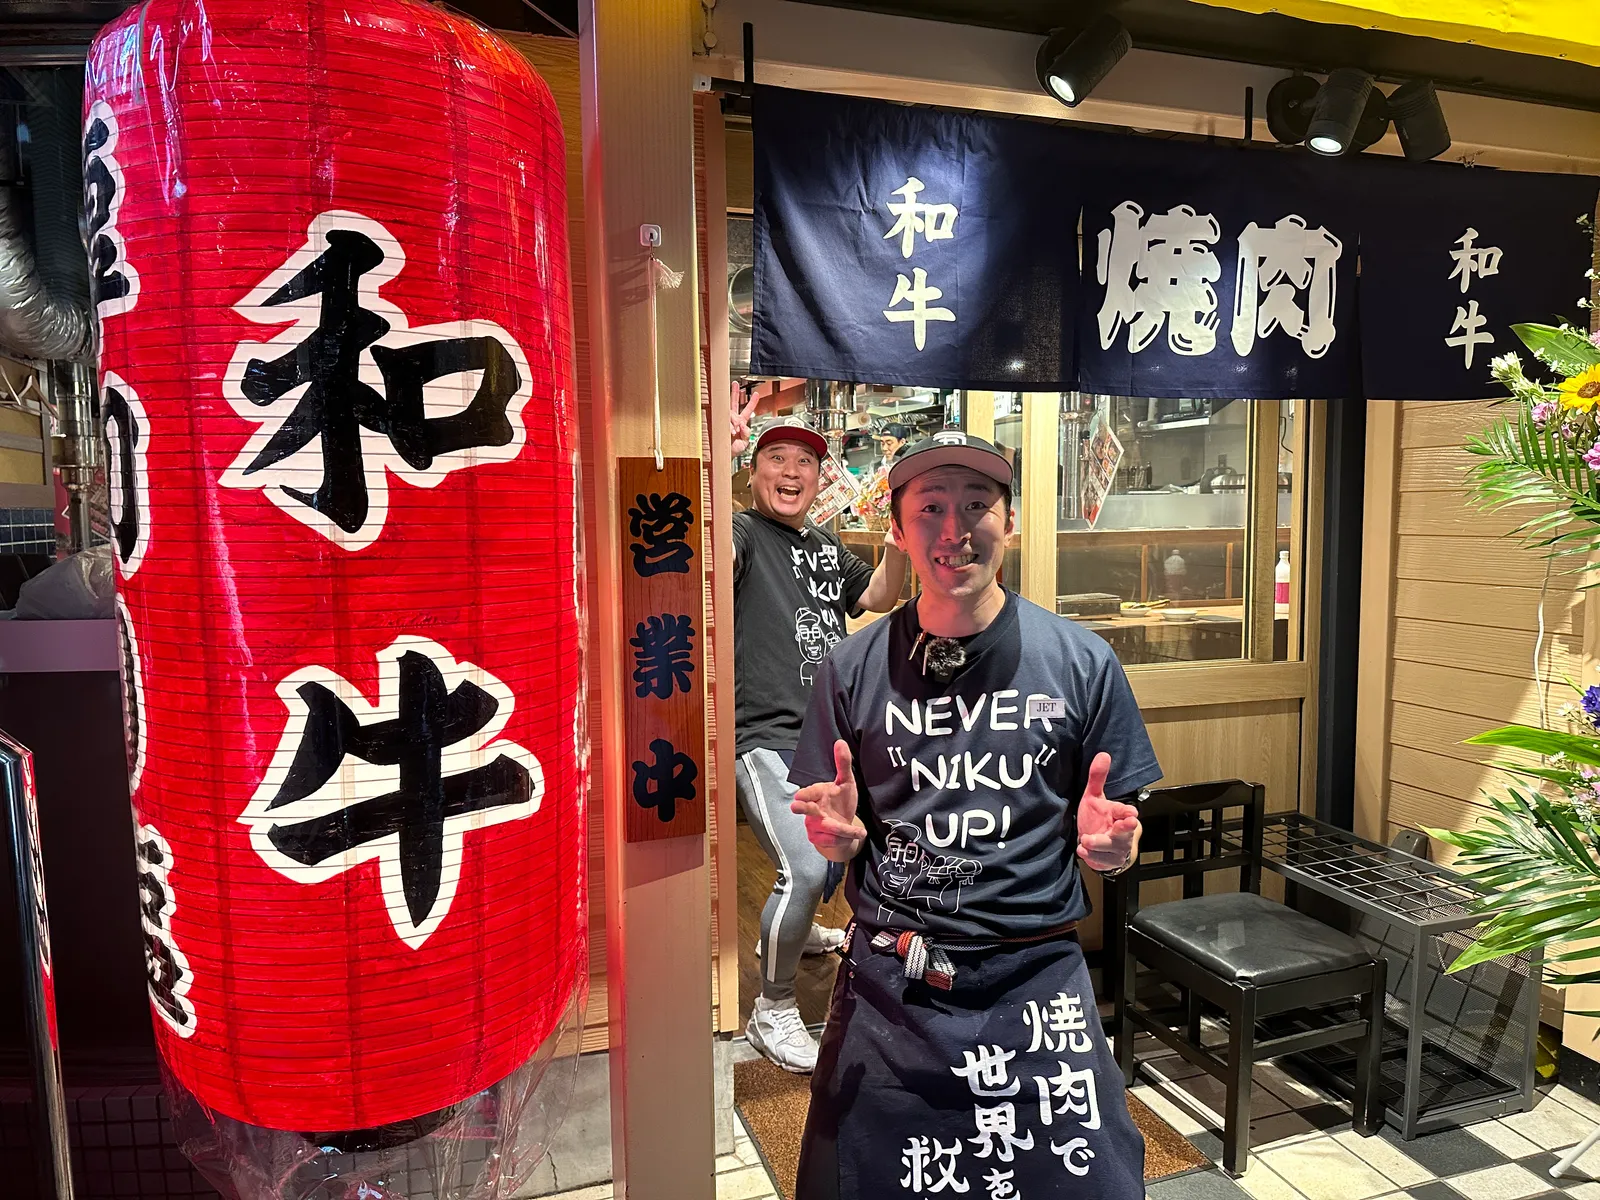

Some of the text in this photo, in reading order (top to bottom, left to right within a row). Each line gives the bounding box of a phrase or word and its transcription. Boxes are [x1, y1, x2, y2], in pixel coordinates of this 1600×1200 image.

[883, 176, 958, 351] 和牛
[1097, 200, 1343, 359] 焼肉
[1444, 227, 1503, 370] 和牛
[237, 225, 538, 933] 和牛
[628, 491, 698, 822] 営業中
[885, 689, 1053, 735] NEVER
[1036, 702, 1057, 713] JET
[925, 805, 1011, 849] UP!
[950, 1044, 1035, 1200] 世界を
[1022, 992, 1103, 1177] 焼肉で
[900, 1135, 970, 1200] 救
